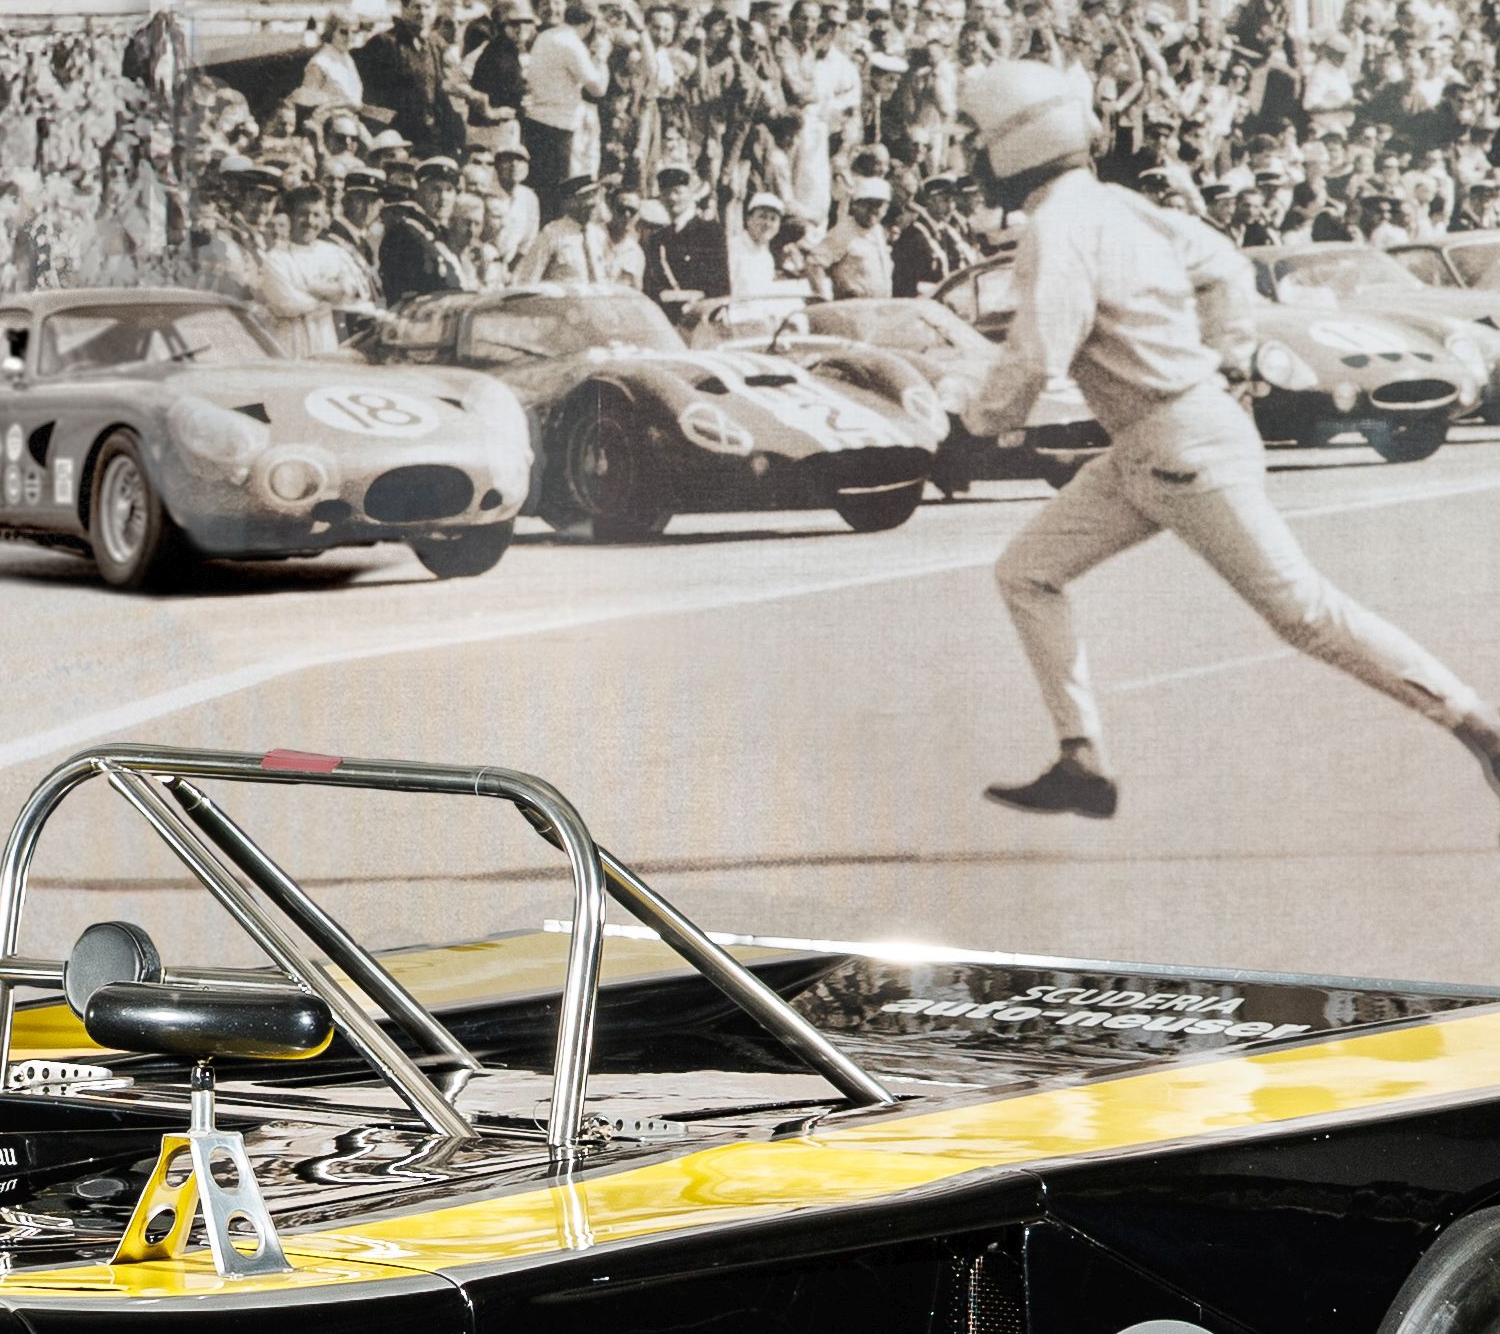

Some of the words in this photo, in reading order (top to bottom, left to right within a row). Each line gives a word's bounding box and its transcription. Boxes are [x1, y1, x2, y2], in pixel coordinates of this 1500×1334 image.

[326, 393, 422, 429] 18
[1011, 984, 1246, 1015] SCUDERIA
[881, 998, 1313, 1040] auto-neuser
